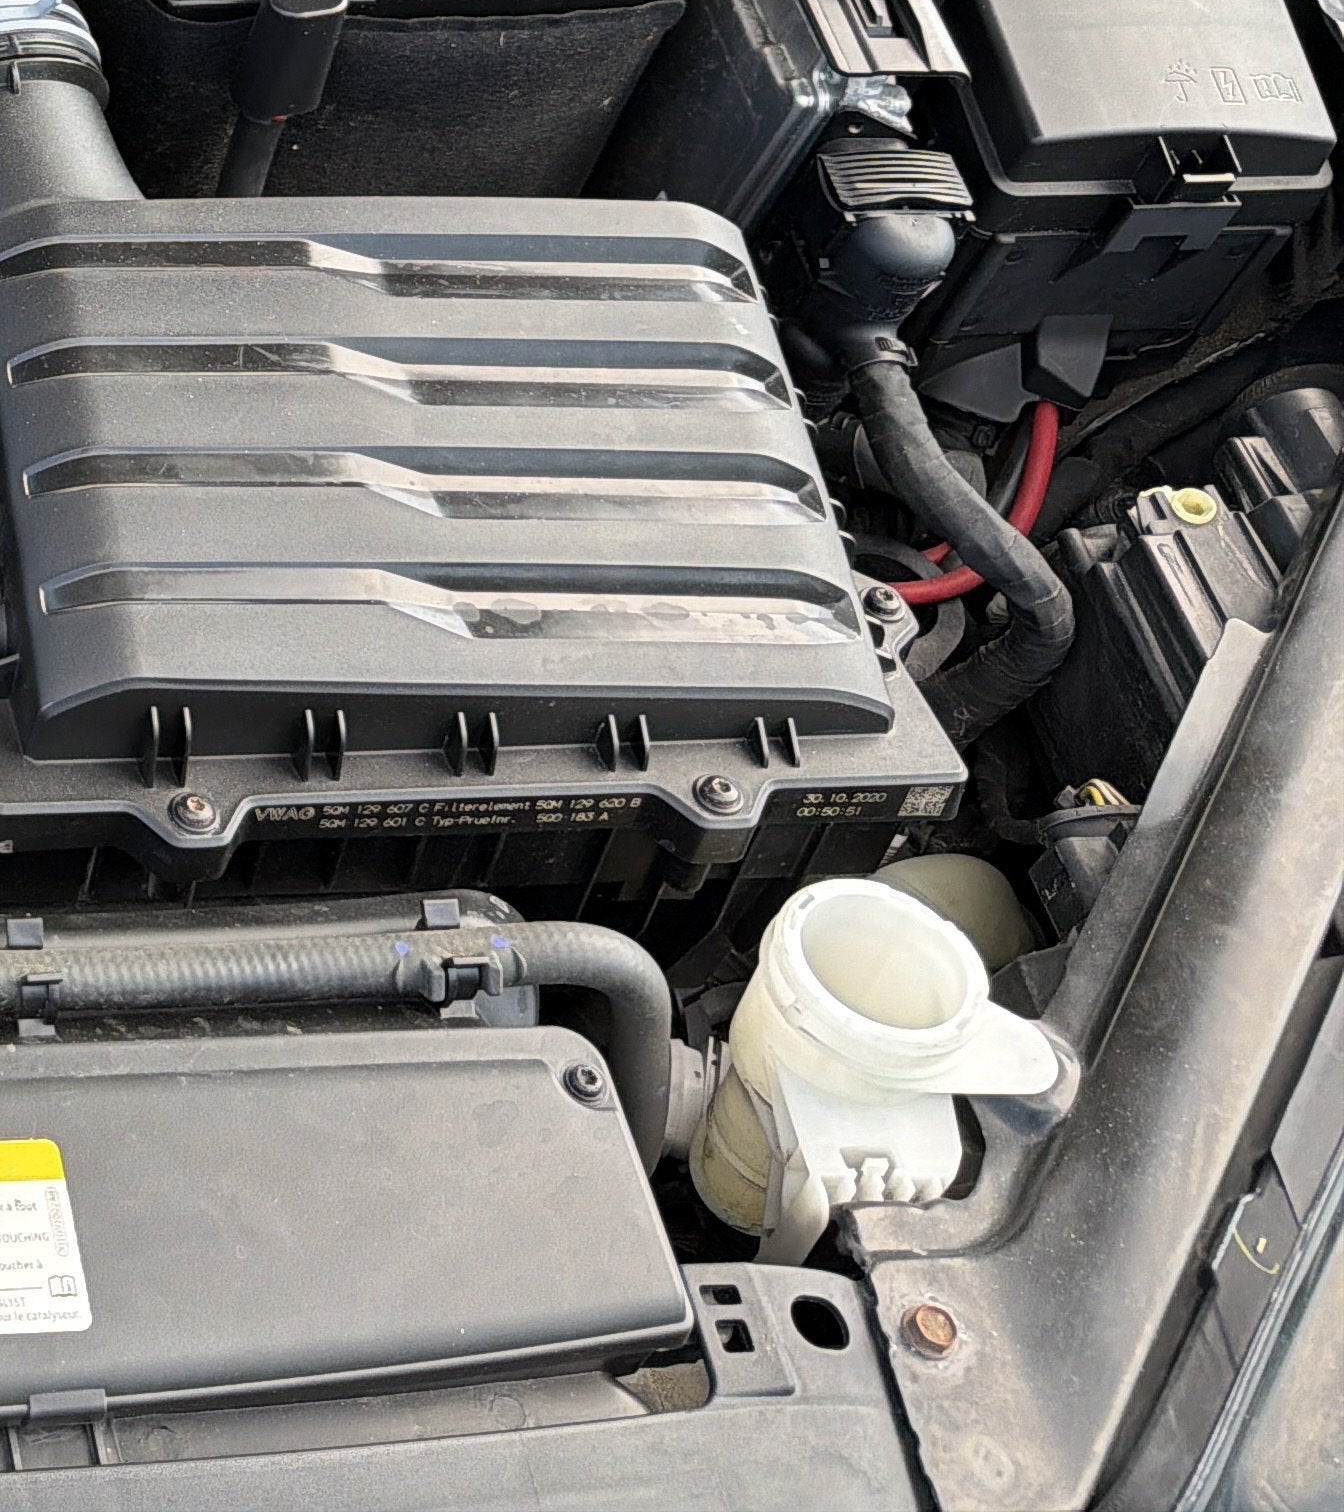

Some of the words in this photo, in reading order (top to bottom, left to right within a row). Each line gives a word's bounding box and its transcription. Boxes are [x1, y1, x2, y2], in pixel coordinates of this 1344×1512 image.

[357, 804, 382, 815] 129
[387, 804, 413, 814] 607
[419, 803, 430, 813] C
[433, 800, 531, 814] Filterelement
[569, 799, 595, 809] 129
[599, 798, 625, 808] 620
[630, 797, 642, 808] B
[796, 804, 863, 817] 00:50:51
[354, 818, 379, 828] 129
[383, 817, 406, 828] 601
[415, 817, 426, 826] C
[596, 811, 609, 822] A
